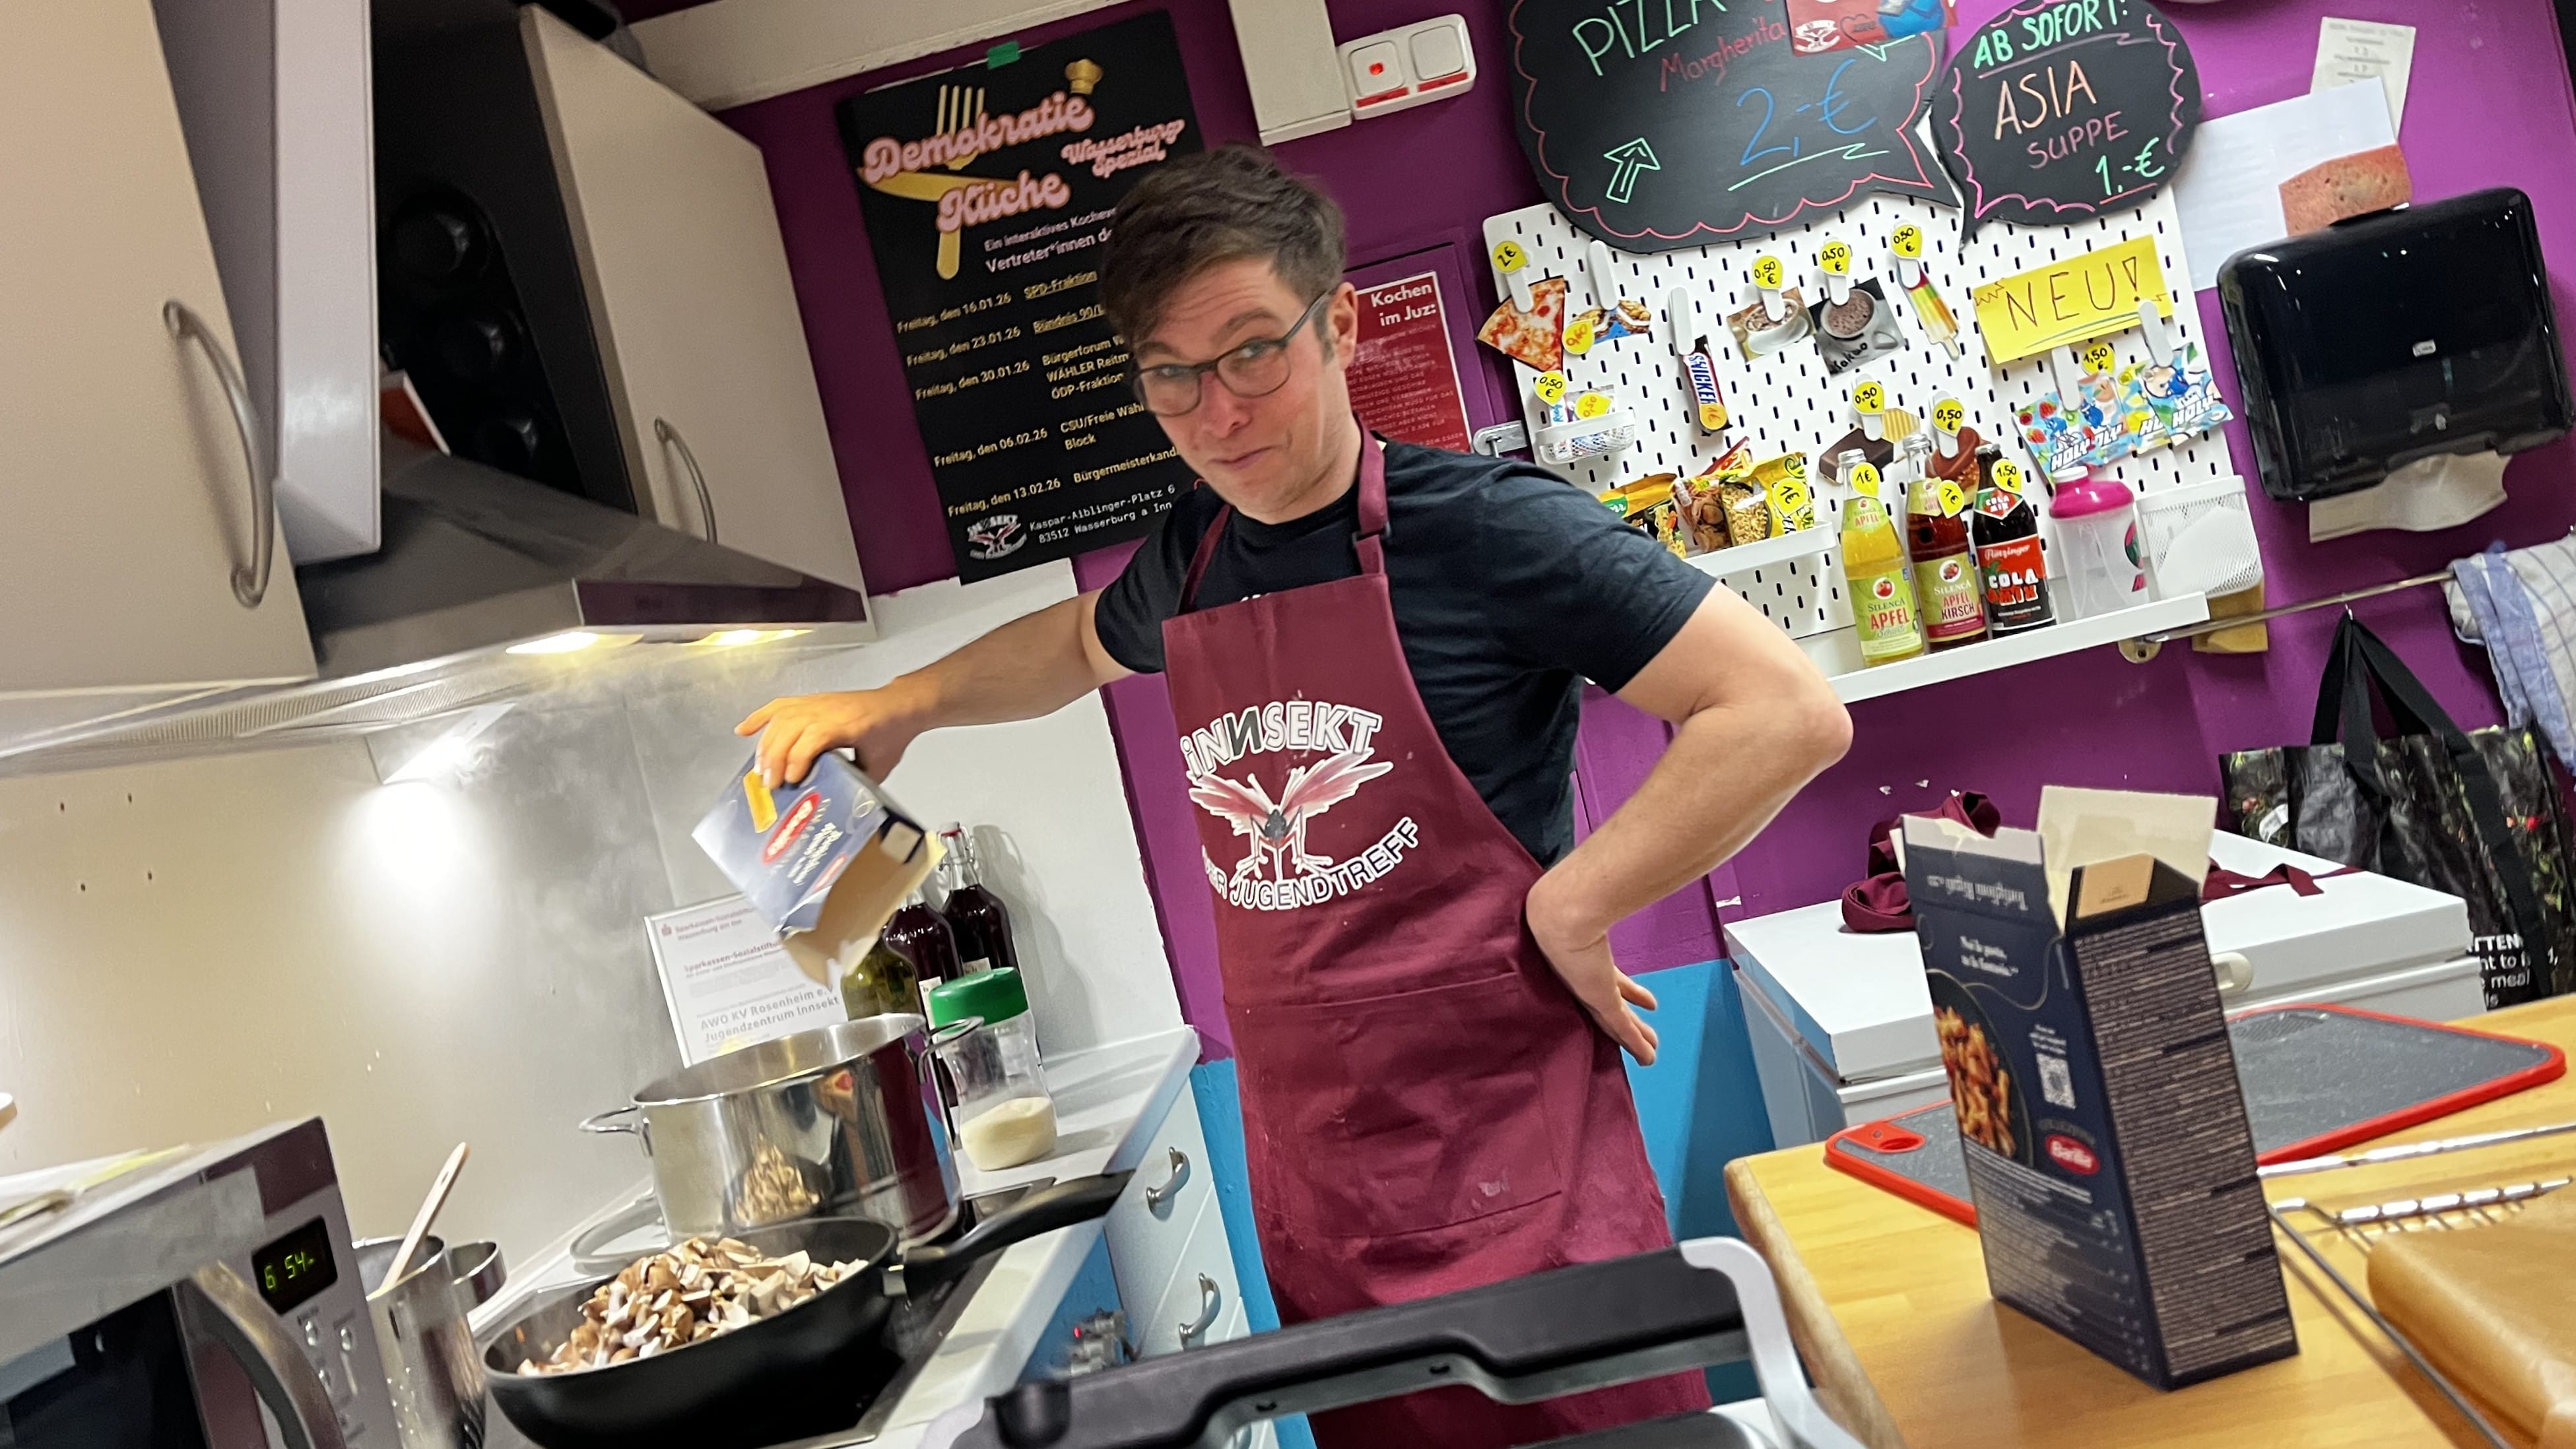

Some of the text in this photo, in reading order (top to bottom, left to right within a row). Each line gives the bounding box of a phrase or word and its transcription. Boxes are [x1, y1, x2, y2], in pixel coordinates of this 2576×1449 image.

[1660, 15, 1787, 92] Margherita
[1973, 28, 2013, 69] AB
[1995, 61, 2097, 141] ASIA
[862, 91, 1094, 183] Demokratie
[1061, 119, 1185, 165] Wasserburg
[2027, 111, 2129, 170] SUPPE
[1092, 141, 1166, 179] Spezial
[936, 170, 1071, 233] Küche
[983, 238, 1003, 252] Ein
[1004, 220, 1069, 246] interaktives
[1893, 227, 1914, 244] 0,50
[1822, 247, 1845, 261] 0,50
[1754, 261, 1776, 279] 0,50
[897, 270, 1098, 333] Freitag, den 16.01.26 SPD-Fraktion
[1371, 284, 1432, 307] Kochen
[2005, 256, 2141, 331] NEU!
[1379, 303, 1436, 327] im Juz:
[906, 348, 948, 367] Freitag,
[949, 341, 970, 355] den
[972, 326, 1021, 350] 23.01.26
[1032, 311, 1078, 335] Bündnis
[1096, 352, 1130, 370] Reitm
[2084, 347, 2107, 364] 1,50
[915, 382, 957, 401] Freitag,
[958, 375, 979, 389] den
[980, 360, 1030, 383] 30.01.26
[1041, 340, 1112, 366] Bürgerforum
[1539, 376, 1563, 389] 0,50
[1688, 354, 1718, 404] SNICKER
[1545, 388, 1554, 397] €
[1854, 387, 1878, 404] 0,50
[1936, 409, 1962, 420] 0,50
[2171, 395, 2216, 430] HOLY
[934, 402, 1145, 467] Freitag, den 06.02.26 CSU/Freie Wähl
[1064, 434, 1097, 451] Block
[2050, 437, 2093, 473] HOLY
[1856, 470, 1873, 484] 1€
[1997, 465, 2017, 476] 1,50
[948, 499, 989, 518] Freitag,
[990, 493, 1011, 506] den
[1013, 478, 1061, 498] 13.02.26
[1780, 486, 1800, 504] 1€
[1985, 496, 2010, 506] COLA
[1989, 502, 2010, 513] MIX
[1029, 484, 1176, 532] Kaspar-Aiblinger-Platz 6
[1855, 513, 1879, 527] APFEL
[1038, 527, 1071, 544] 83512
[1074, 511, 1137, 534] Wasserburg
[1153, 501, 1173, 513] Inn
[1988, 568, 2039, 589] COLA
[1942, 591, 1970, 608] APFEL
[1999, 585, 2039, 606] MIX
[1869, 606, 1910, 631] APFEL
[1941, 602, 1975, 621] KIRSCH
[1229, 816, 1419, 911] JUGENDTREFF
[2465, 932, 2524, 953] TTEN
[2499, 953, 2517, 969] to
[700, 1014, 729, 1031] AWO
[731, 1008, 748, 1022] KV
[750, 991, 814, 1017] Rosenheim
[705, 995, 840, 1043] Jugendzentrum Innsekt
[264, 1264, 277, 1291] 6
